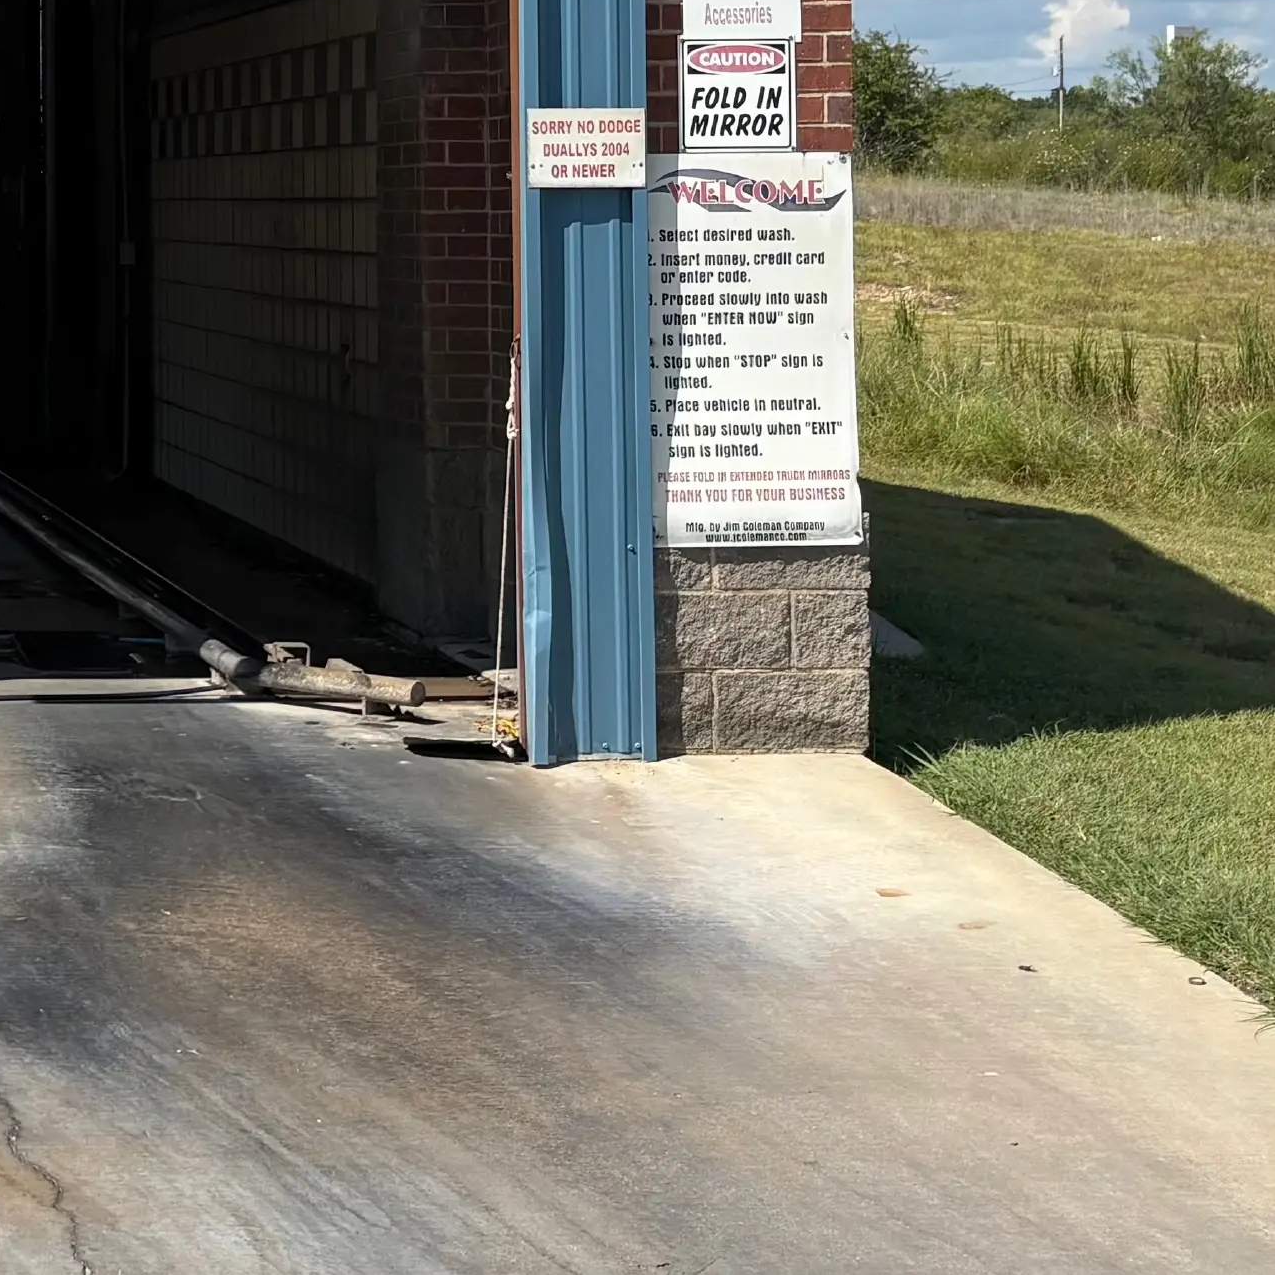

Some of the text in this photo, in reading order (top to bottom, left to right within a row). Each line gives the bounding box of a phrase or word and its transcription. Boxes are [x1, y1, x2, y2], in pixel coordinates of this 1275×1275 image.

[705, 4, 772, 25] Accessories
[699, 51, 775, 66] CAUTION
[692, 86, 782, 109] FOLD IN
[532, 120, 641, 134] SORRY NO DODGE
[690, 114, 783, 137] MIRROR
[543, 142, 629, 157] DUALLYS 2004
[551, 164, 615, 178] OR NEWER
[667, 179, 825, 205] WELCOME
[659, 229, 698, 242] Select
[703, 228, 752, 241] desired
[757, 228, 795, 241] wash.
[661, 253, 700, 266] Insert
[754, 252, 791, 265] credit
[796, 252, 825, 264] card
[661, 270, 751, 283] or enter code.
[662, 293, 714, 305] Proceed
[719, 293, 761, 306] slowly
[766, 292, 789, 305] into
[794, 291, 828, 304] wash
[663, 313, 697, 325] when
[788, 312, 814, 325] sign
[663, 333, 726, 347] is lighted.
[664, 356, 691, 369] Stop
[696, 356, 729, 368] when
[781, 354, 808, 368] sign
[812, 354, 823, 366] is
[665, 376, 712, 390] lighted.
[650, 398, 821, 412] 5. Place vehicle in neutral.
[651, 425, 662, 437] 6.
[667, 423, 689, 437] Exit
[694, 423, 716, 437] bay
[721, 422, 762, 436] slowly
[767, 422, 801, 435] when
[668, 444, 763, 458] sign is lighted.
[658, 470, 850, 482] PLEASE FOLD IN EXTENDED TRUCK MIRRORS
[666, 488, 845, 503] THANK YOU FOR YOUR BUSINESS
[710, 523, 720, 532] by
[723, 522, 740, 532] Jim
[743, 522, 782, 531] Coleman
[784, 521, 825, 531] Company
